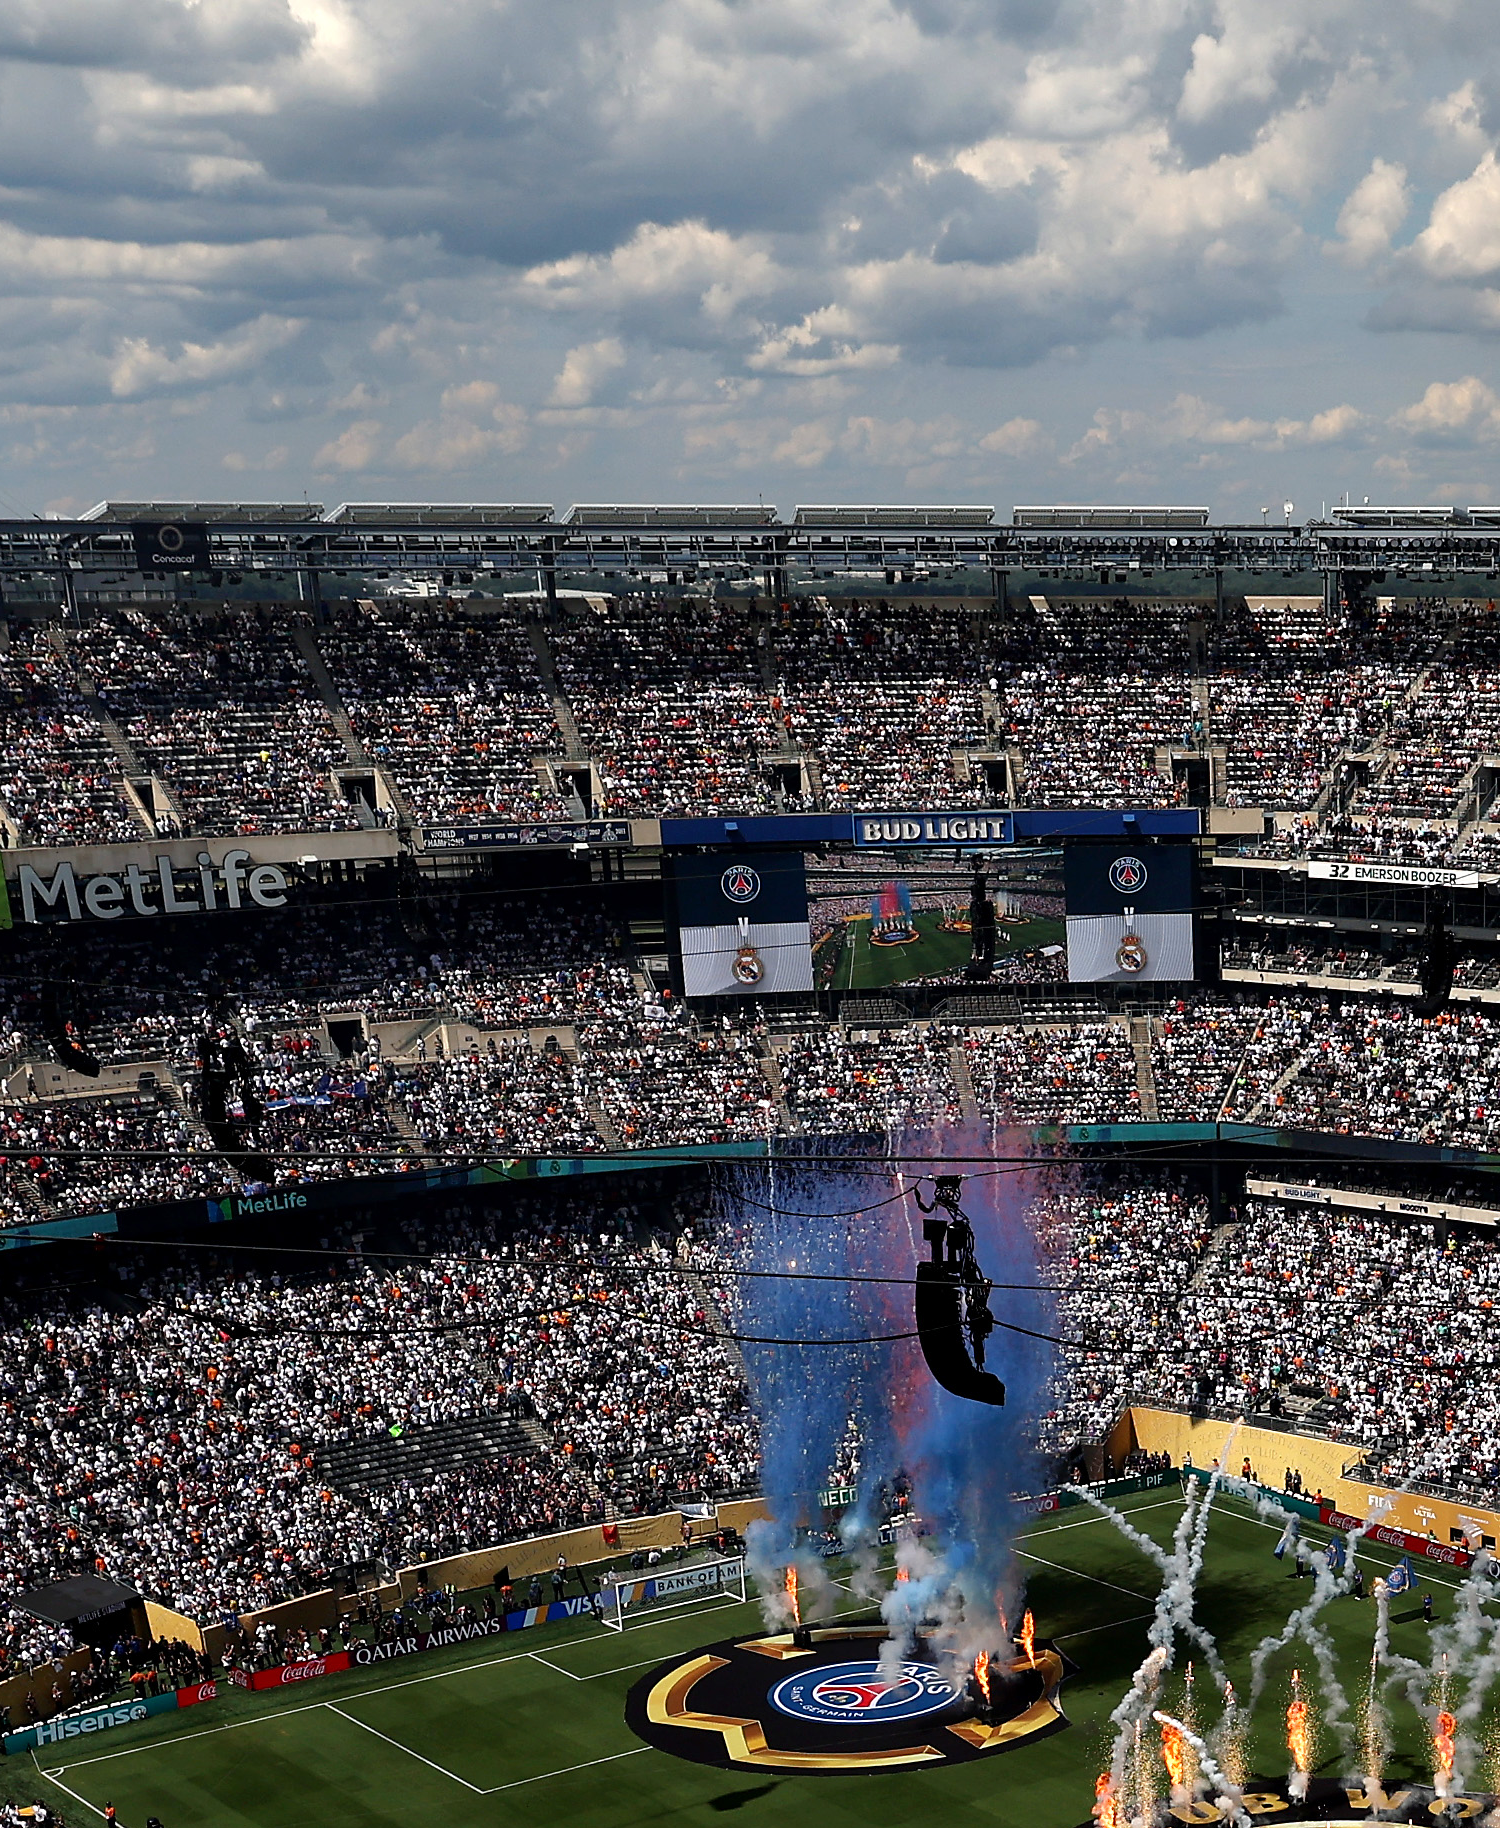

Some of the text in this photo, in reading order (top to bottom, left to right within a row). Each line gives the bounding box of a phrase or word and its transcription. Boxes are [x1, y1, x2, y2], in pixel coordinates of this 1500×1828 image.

[151, 553, 196, 565] Concacaf
[430, 830, 456, 840] WORLD
[863, 816, 1005, 842] BUD LIGHT
[423, 837, 465, 848] CHAMPIONS
[18, 849, 288, 923] MetLife
[1329, 864, 1457, 886] 32 EMERSON BOOZER
[237, 1192, 308, 1216] MetLife
[1283, 1189, 1321, 1199] BUD LIGHT
[1146, 1473, 1163, 1488] PIF
[1413, 1507, 1437, 1519] ULTRA
[1376, 1527, 1406, 1548] Coca-Cola
[1426, 1544, 1455, 1563] Coca-Cola
[658, 1575, 695, 1592] BANK
[699, 1570, 717, 1586] OF
[77, 1601, 126, 1625] METLIFE STADIUM
[562, 1592, 604, 1617] VISA
[355, 1616, 501, 1666] QATAR AIRWAYS
[281, 1657, 326, 1683] Coca-Cola
[875, 1663, 953, 1695] PARIS
[35, 1704, 148, 1747] Hisense
